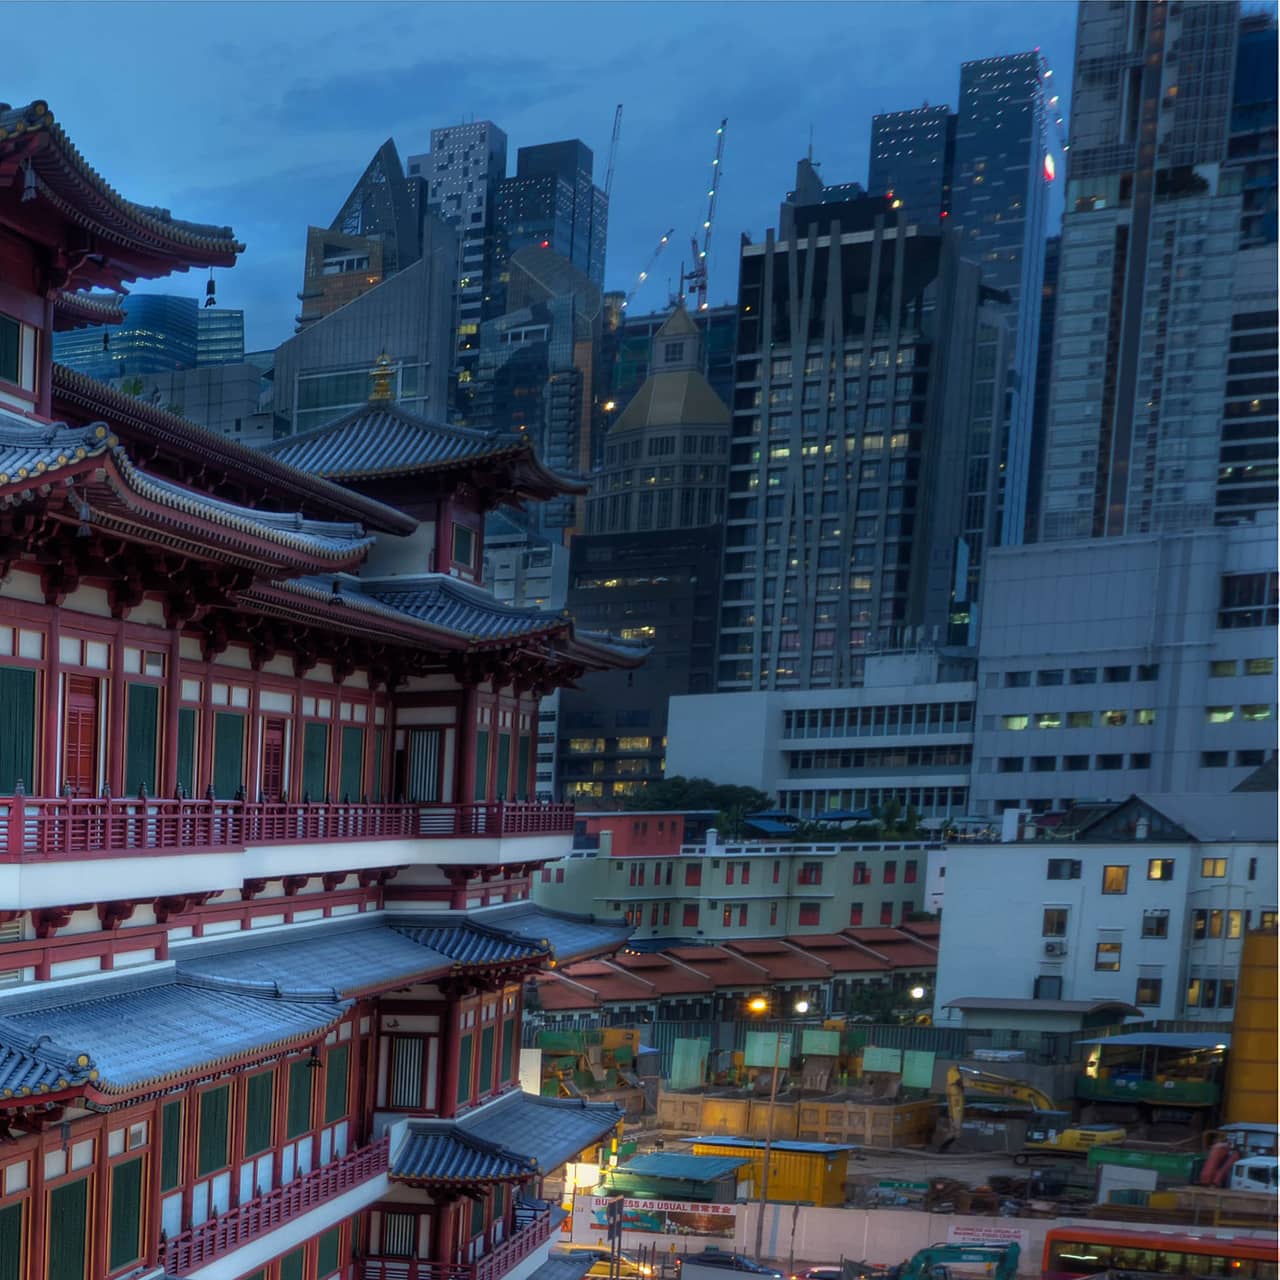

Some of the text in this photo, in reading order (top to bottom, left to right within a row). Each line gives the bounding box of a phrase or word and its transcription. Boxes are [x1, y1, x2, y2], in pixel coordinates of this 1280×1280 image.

[595, 1198, 688, 1211] BUESS AS USUAL
